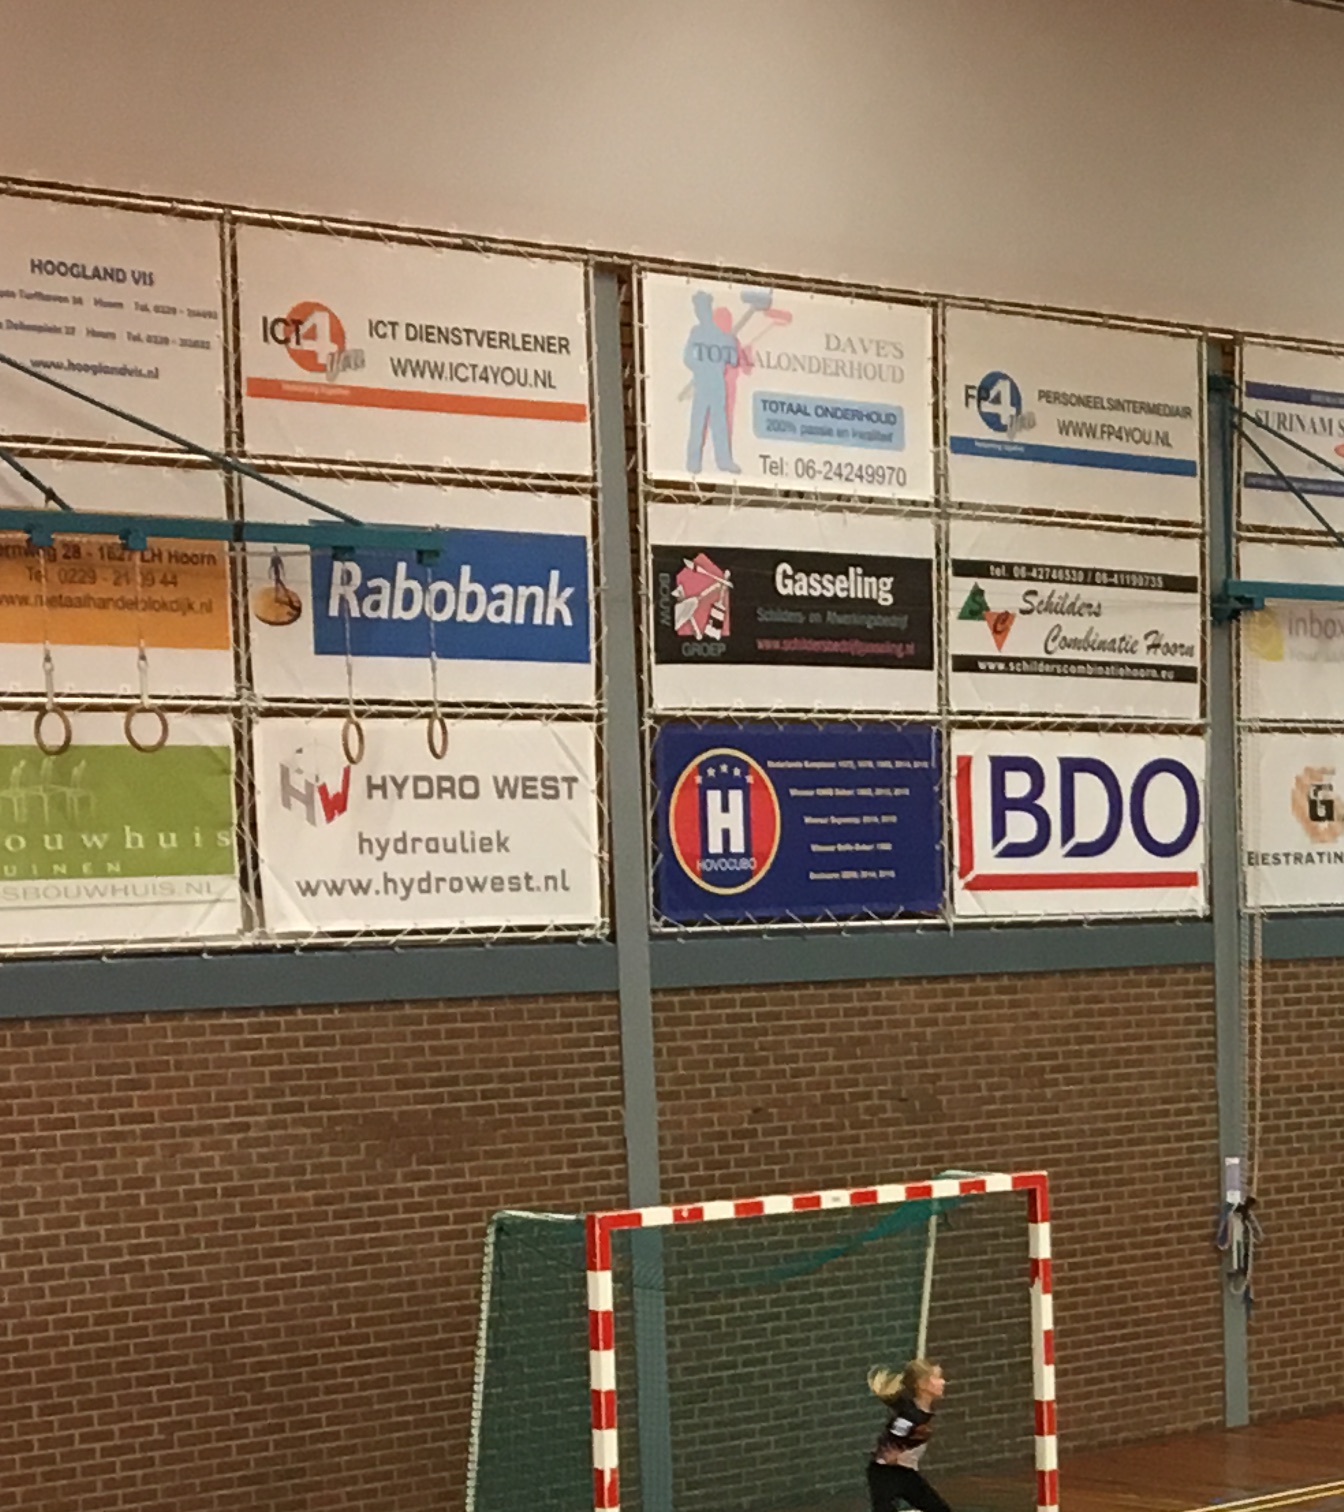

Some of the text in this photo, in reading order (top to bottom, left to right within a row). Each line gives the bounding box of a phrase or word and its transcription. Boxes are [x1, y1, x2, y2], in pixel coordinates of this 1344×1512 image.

[30, 258, 154, 286] HOOGLAND VIS
[368, 319, 570, 355] ICT DIENSTVERLENER
[390, 357, 557, 389] WWW.ICT4YOU.NL
[760, 399, 897, 426] TOTAAL ONDERHOUD
[1038, 389, 1193, 419] PERSONEELSINTERMEDIAIR
[1057, 418, 1173, 448] WWW.FP4YOU.NL
[1254, 408, 1333, 436] SURINAM
[758, 454, 907, 487] Tel: 06-24249970
[62, 544, 81, 560] 28
[168, 549, 217, 566] Hoorn
[57, 568, 97, 585] 0229
[775, 562, 894, 606] Gasseling
[328, 560, 575, 627] Rabobank
[1018, 589, 1102, 617] Schilders
[681, 642, 726, 657] GROEP
[1043, 623, 1195, 658] Combinatie Hoorn
[366, 775, 579, 801] HYDRO WEST
[706, 789, 745, 854] H
[988, 755, 1200, 859] BDO
[358, 830, 511, 861] hydrauliek
[295, 868, 571, 901] www.hydrowest.nl
